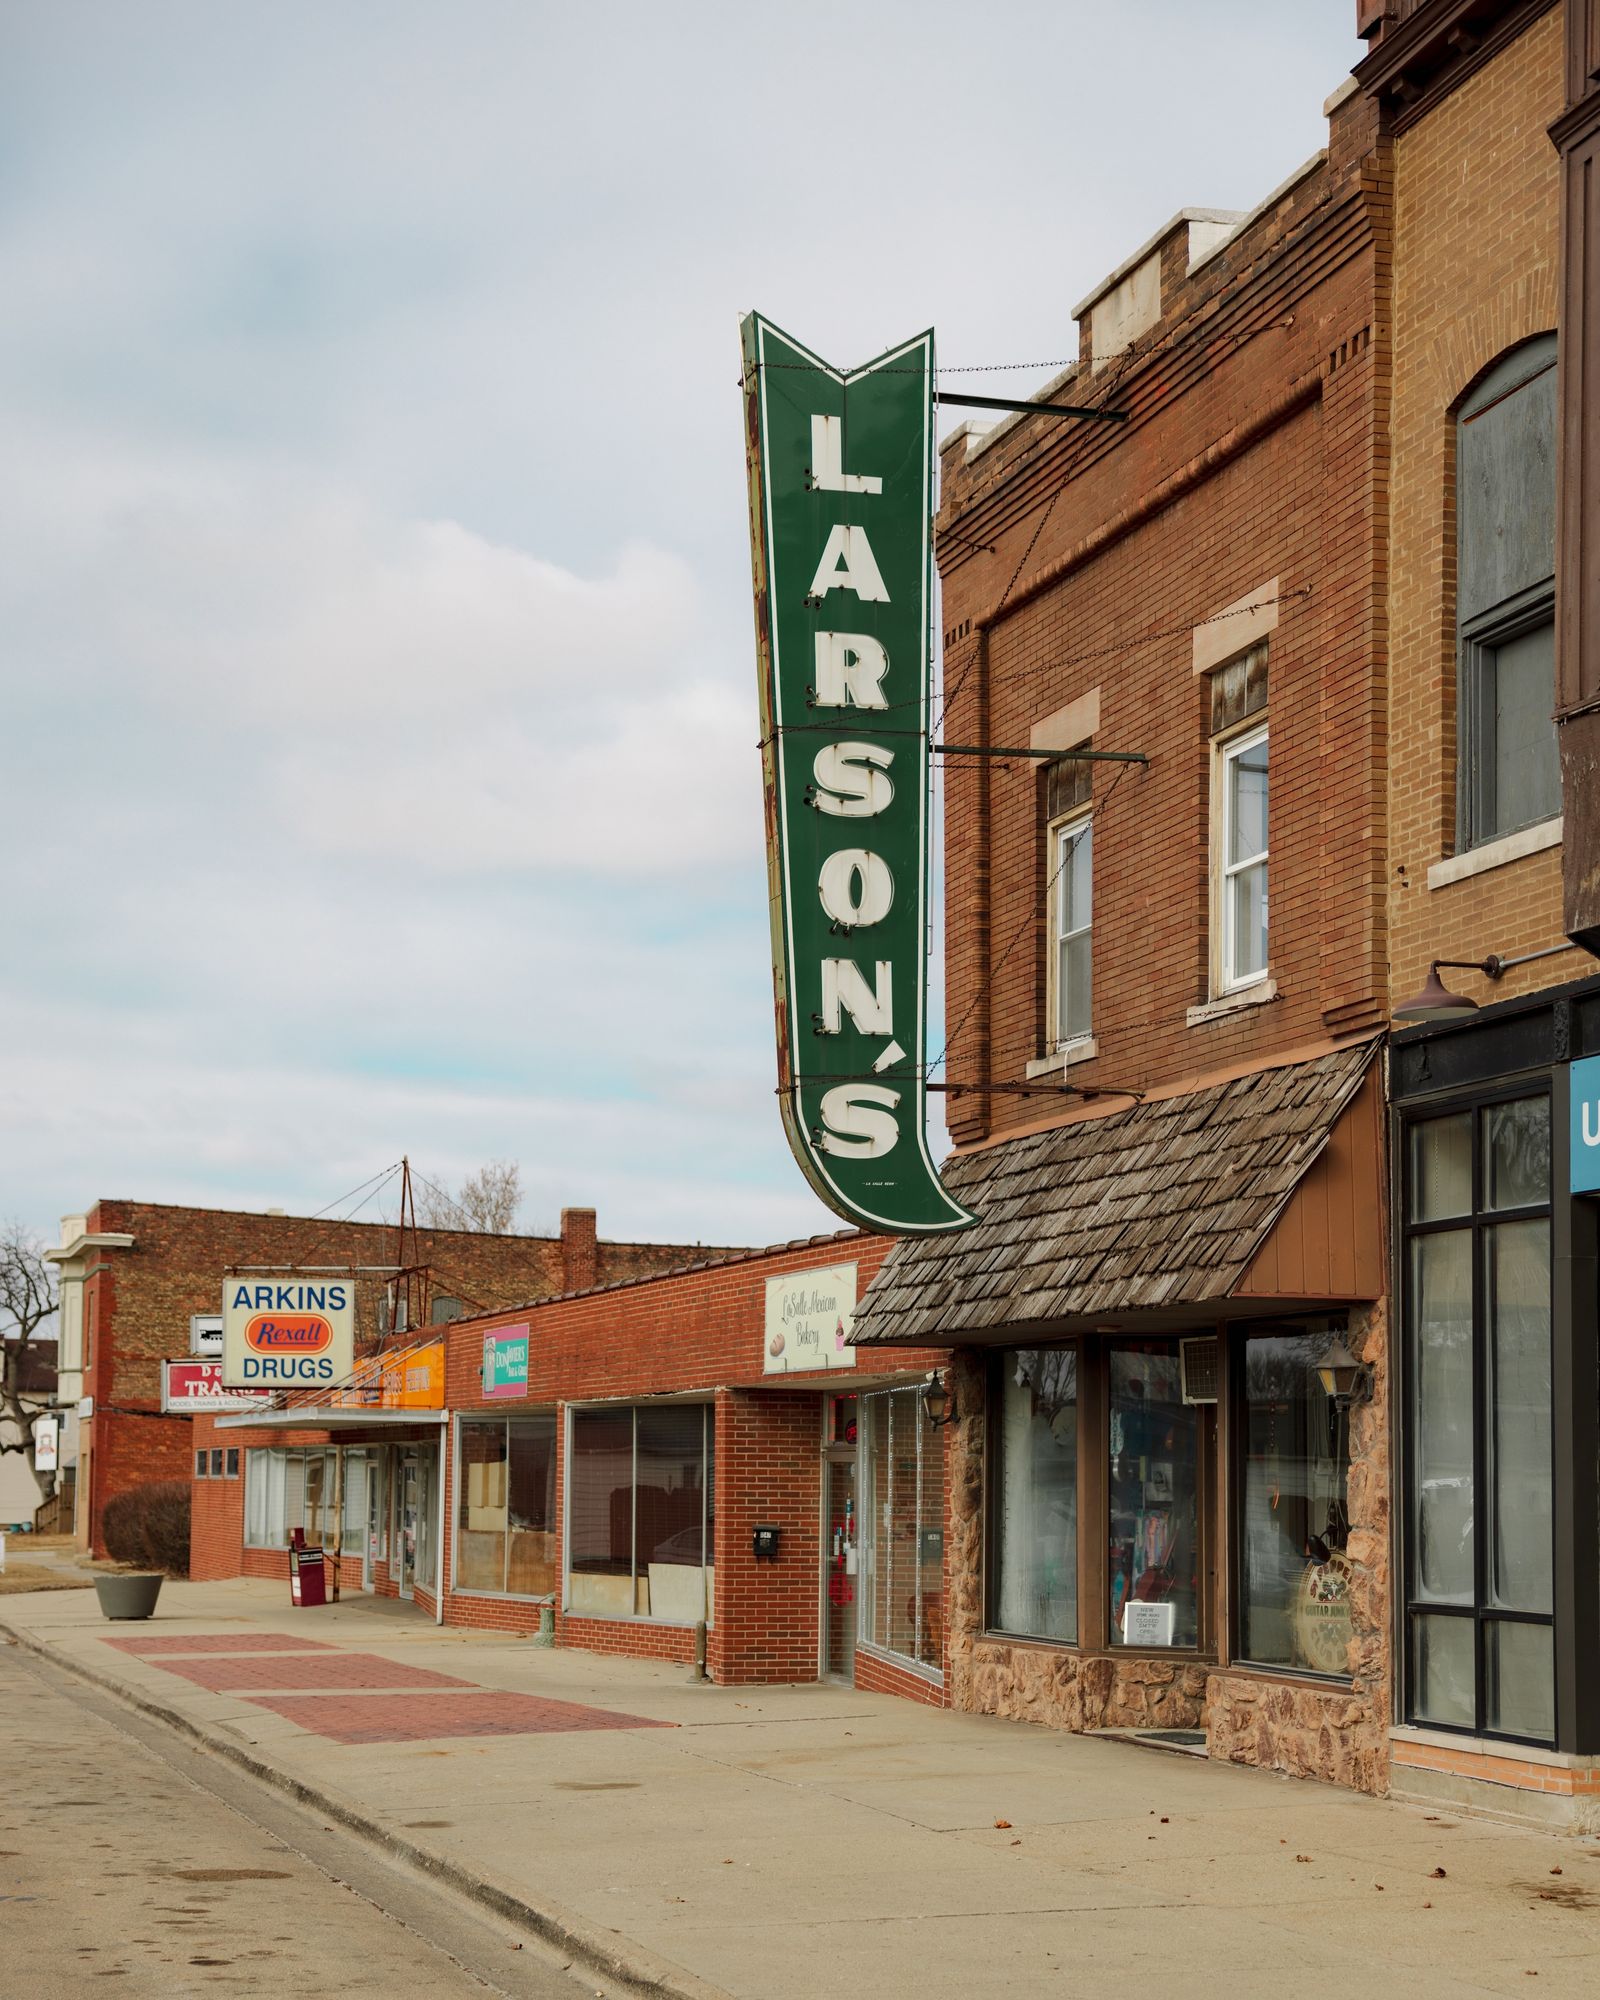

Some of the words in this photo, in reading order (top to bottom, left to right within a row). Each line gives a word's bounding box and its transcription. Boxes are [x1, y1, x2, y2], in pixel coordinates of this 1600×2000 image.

[232, 1286, 347, 1311] ARKINS
[256, 1322, 323, 1345] Rexall
[796, 1321, 821, 1354] Bakery
[243, 1358, 334, 1379] DRUGS
